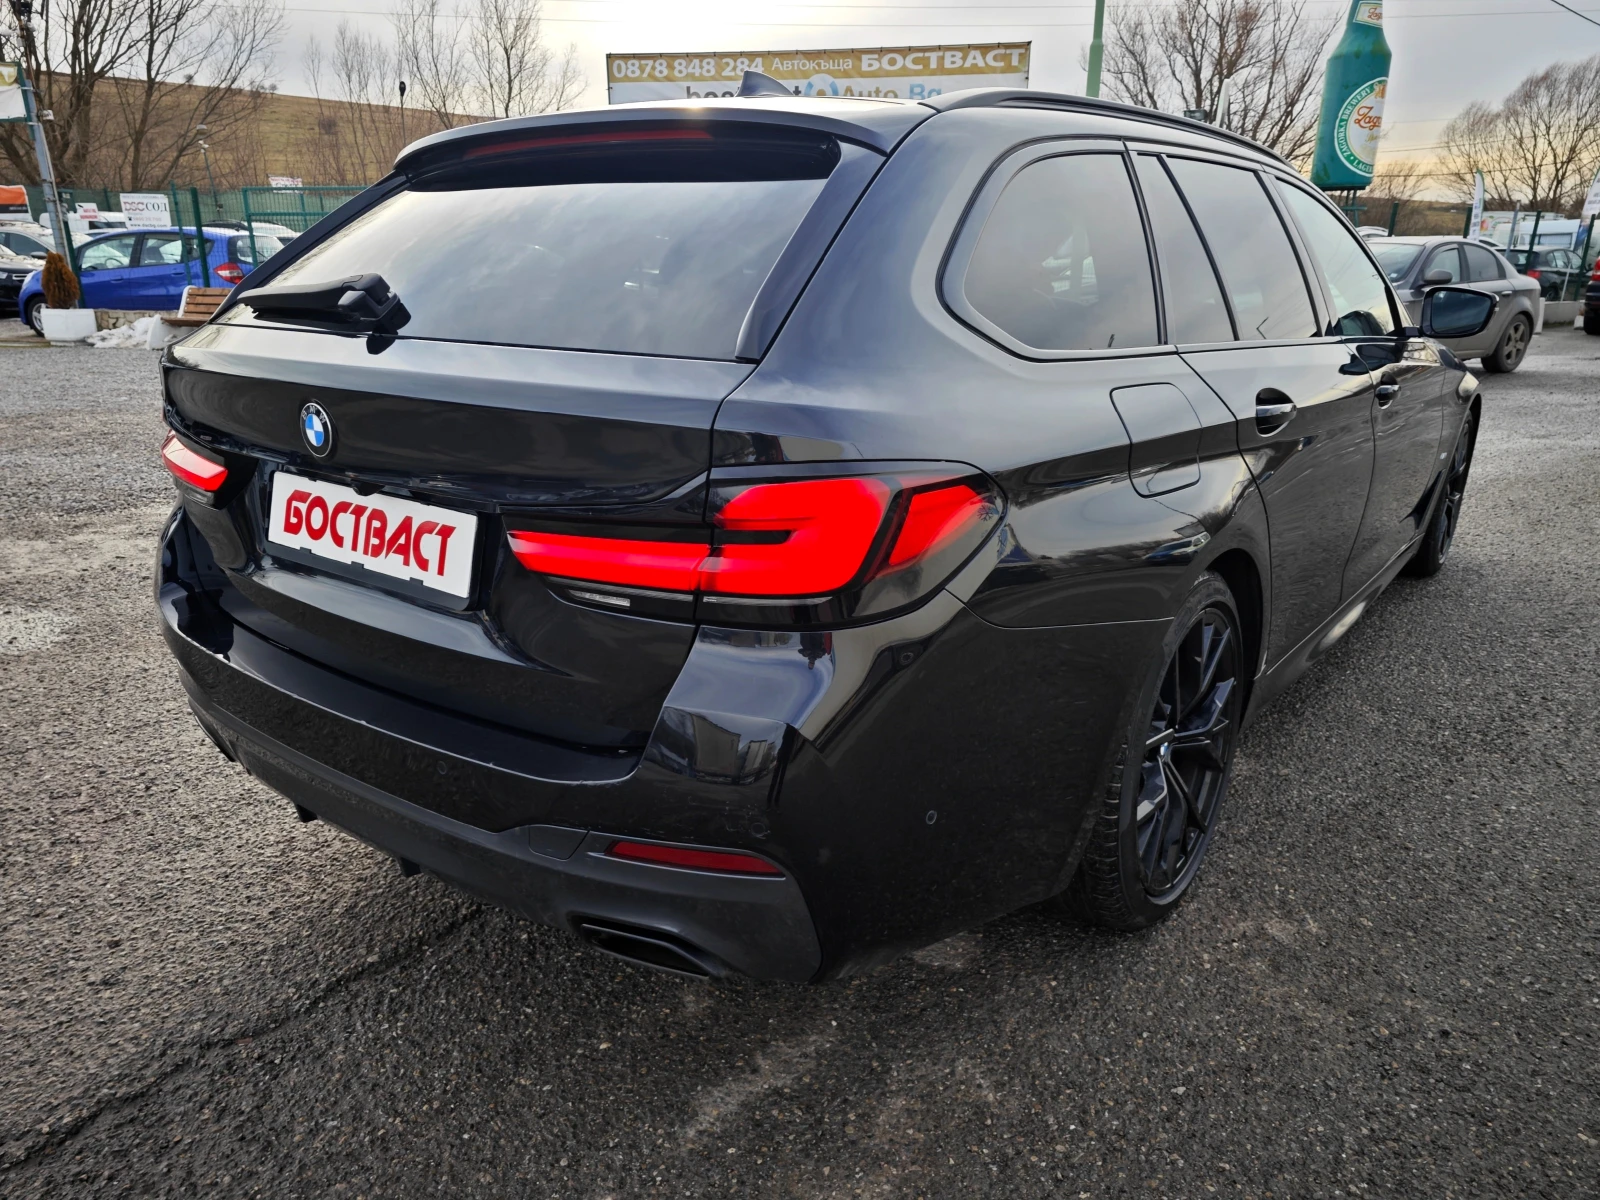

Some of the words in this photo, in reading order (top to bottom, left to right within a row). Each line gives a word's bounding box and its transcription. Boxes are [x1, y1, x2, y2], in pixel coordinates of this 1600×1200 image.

[612, 59, 669, 78] 0878
[673, 58, 716, 77] 848
[721, 57, 764, 76] 284
[771, 57, 853, 72] Автокъща
[861, 48, 1025, 71] БОСТВАСТ
[1342, 87, 1371, 119] BREWERY
[1338, 121, 1351, 157] ZAGORKA
[302, 405, 326, 423] BMW
[283, 490, 456, 576] БОСТВАСТ
